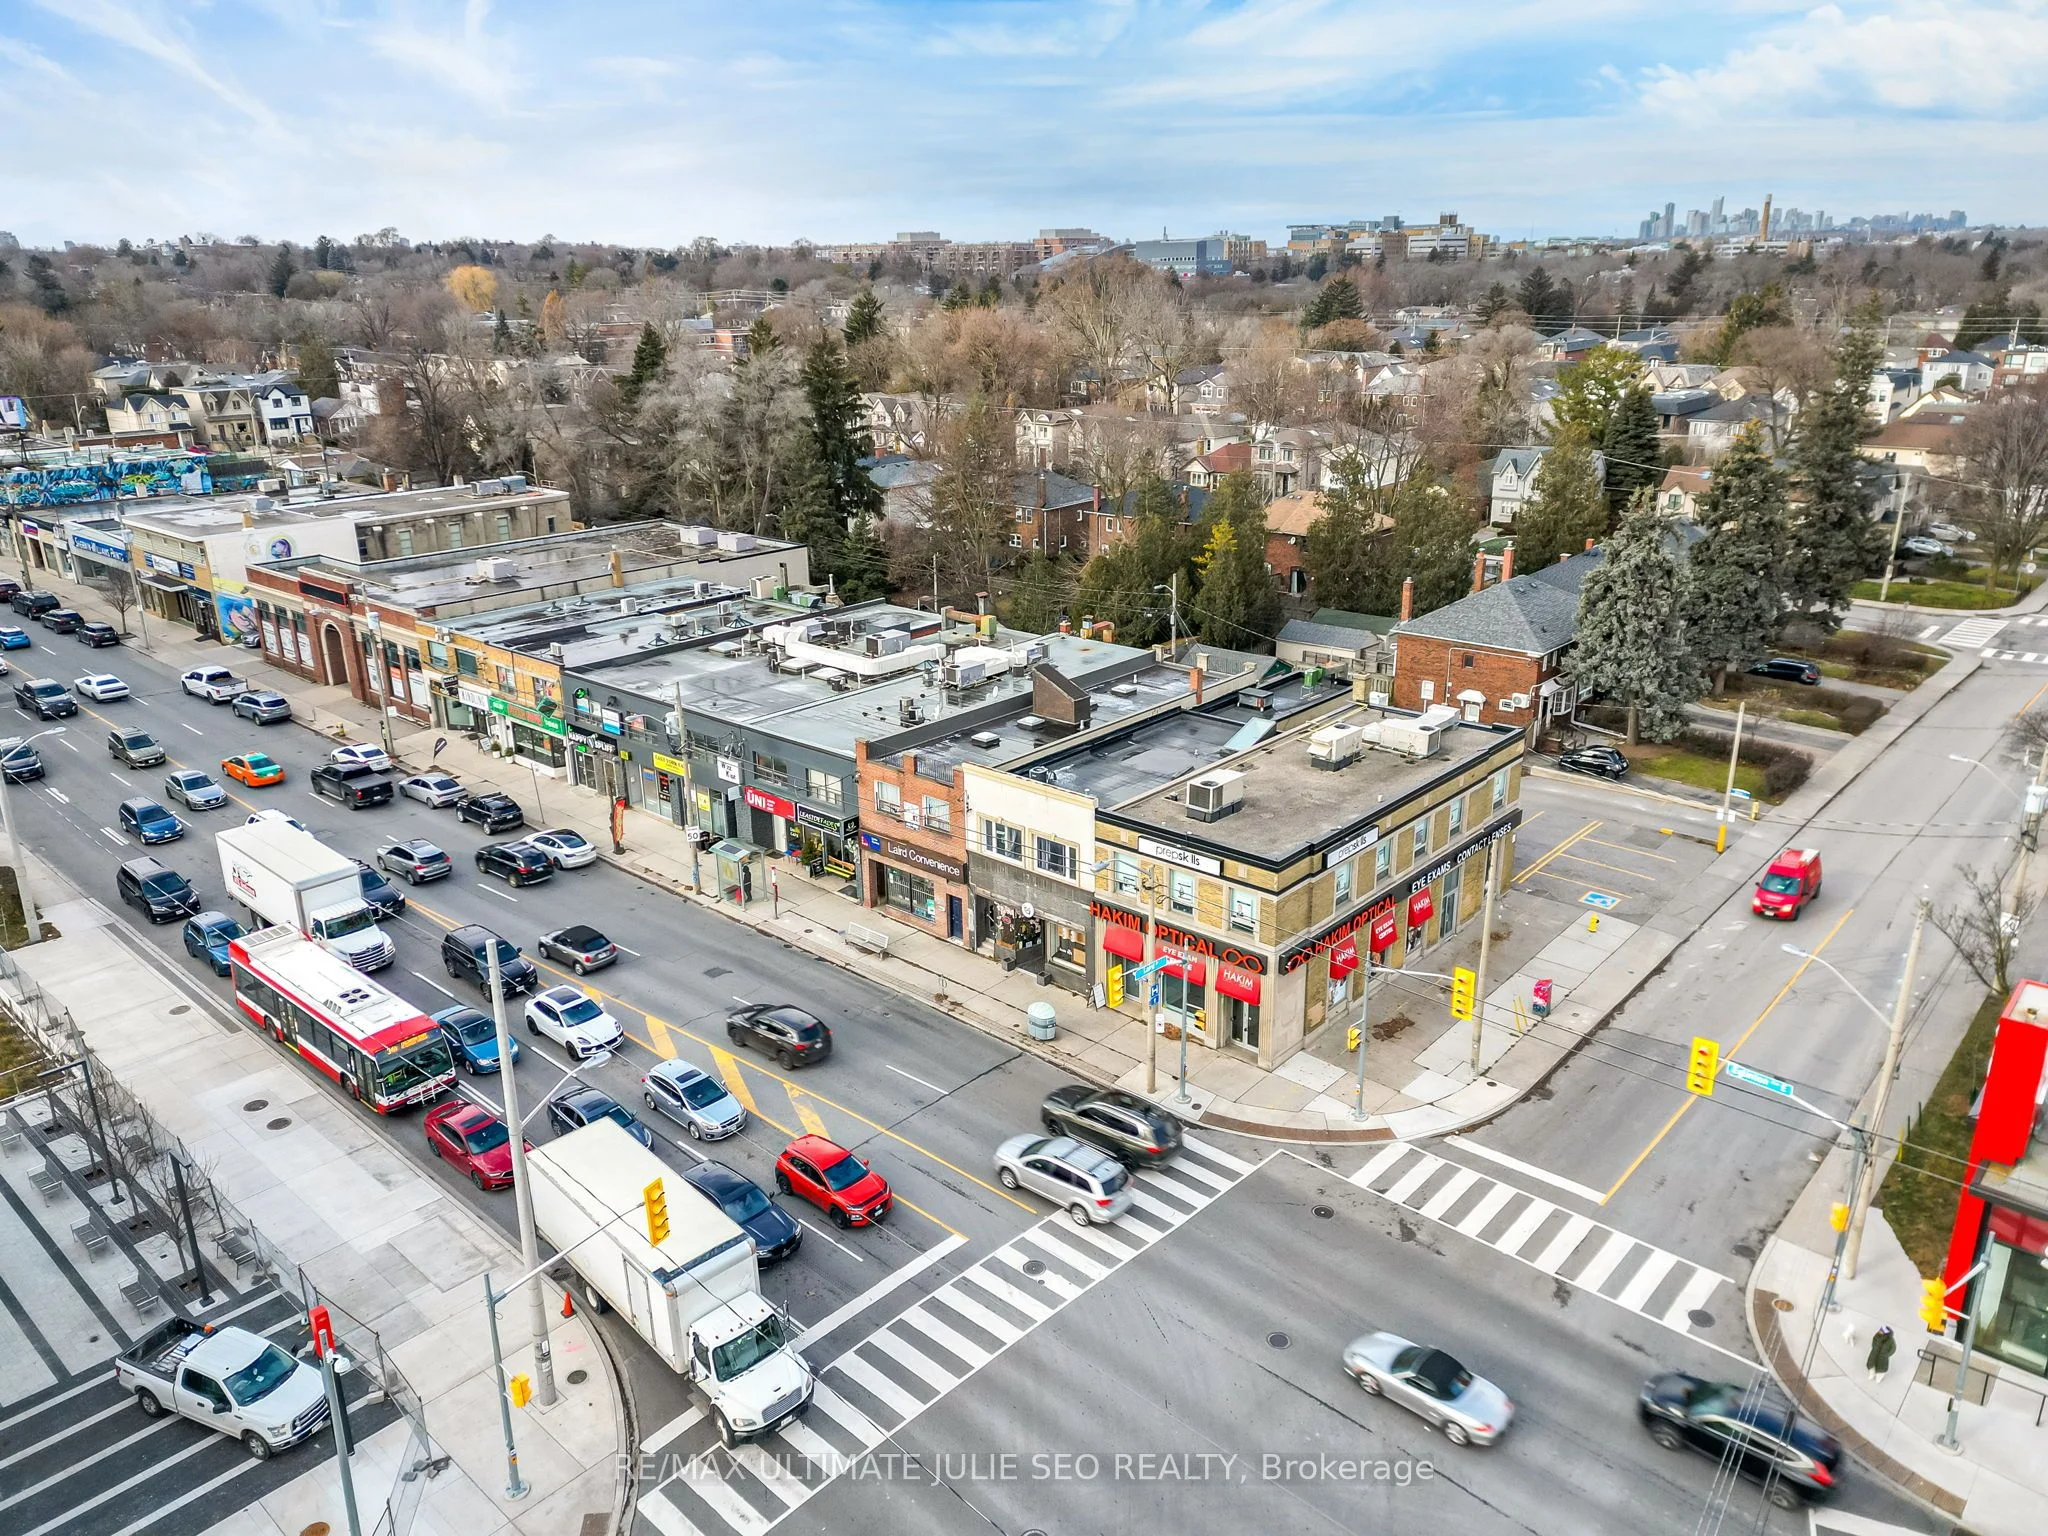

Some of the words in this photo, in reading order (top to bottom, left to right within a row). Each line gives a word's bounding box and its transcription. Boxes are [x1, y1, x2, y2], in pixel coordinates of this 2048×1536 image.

[687, 832, 699, 840] 50
[1456, 836, 1488, 864] CONTACT
[1487, 822, 1512, 846] LENSES
[887, 841, 908, 858] Laird
[908, 849, 960, 877] Convenience
[1155, 846, 1200, 866] prepsklls
[1411, 875, 1427, 893] EYE
[1426, 861, 1451, 885] EXAMS
[1413, 896, 1430, 912] HAKIM
[1089, 901, 1141, 932] HAKIM
[1145, 922, 1220, 960] OPTICAL
[1315, 922, 1351, 955] HAKIM
[1353, 895, 1398, 932] OPTICAL
[1162, 945, 1177, 955] EYE
[1335, 946, 1356, 965] HAKIM
[1223, 969, 1254, 988] HAKIM
[1151, 984, 1159, 998] H
